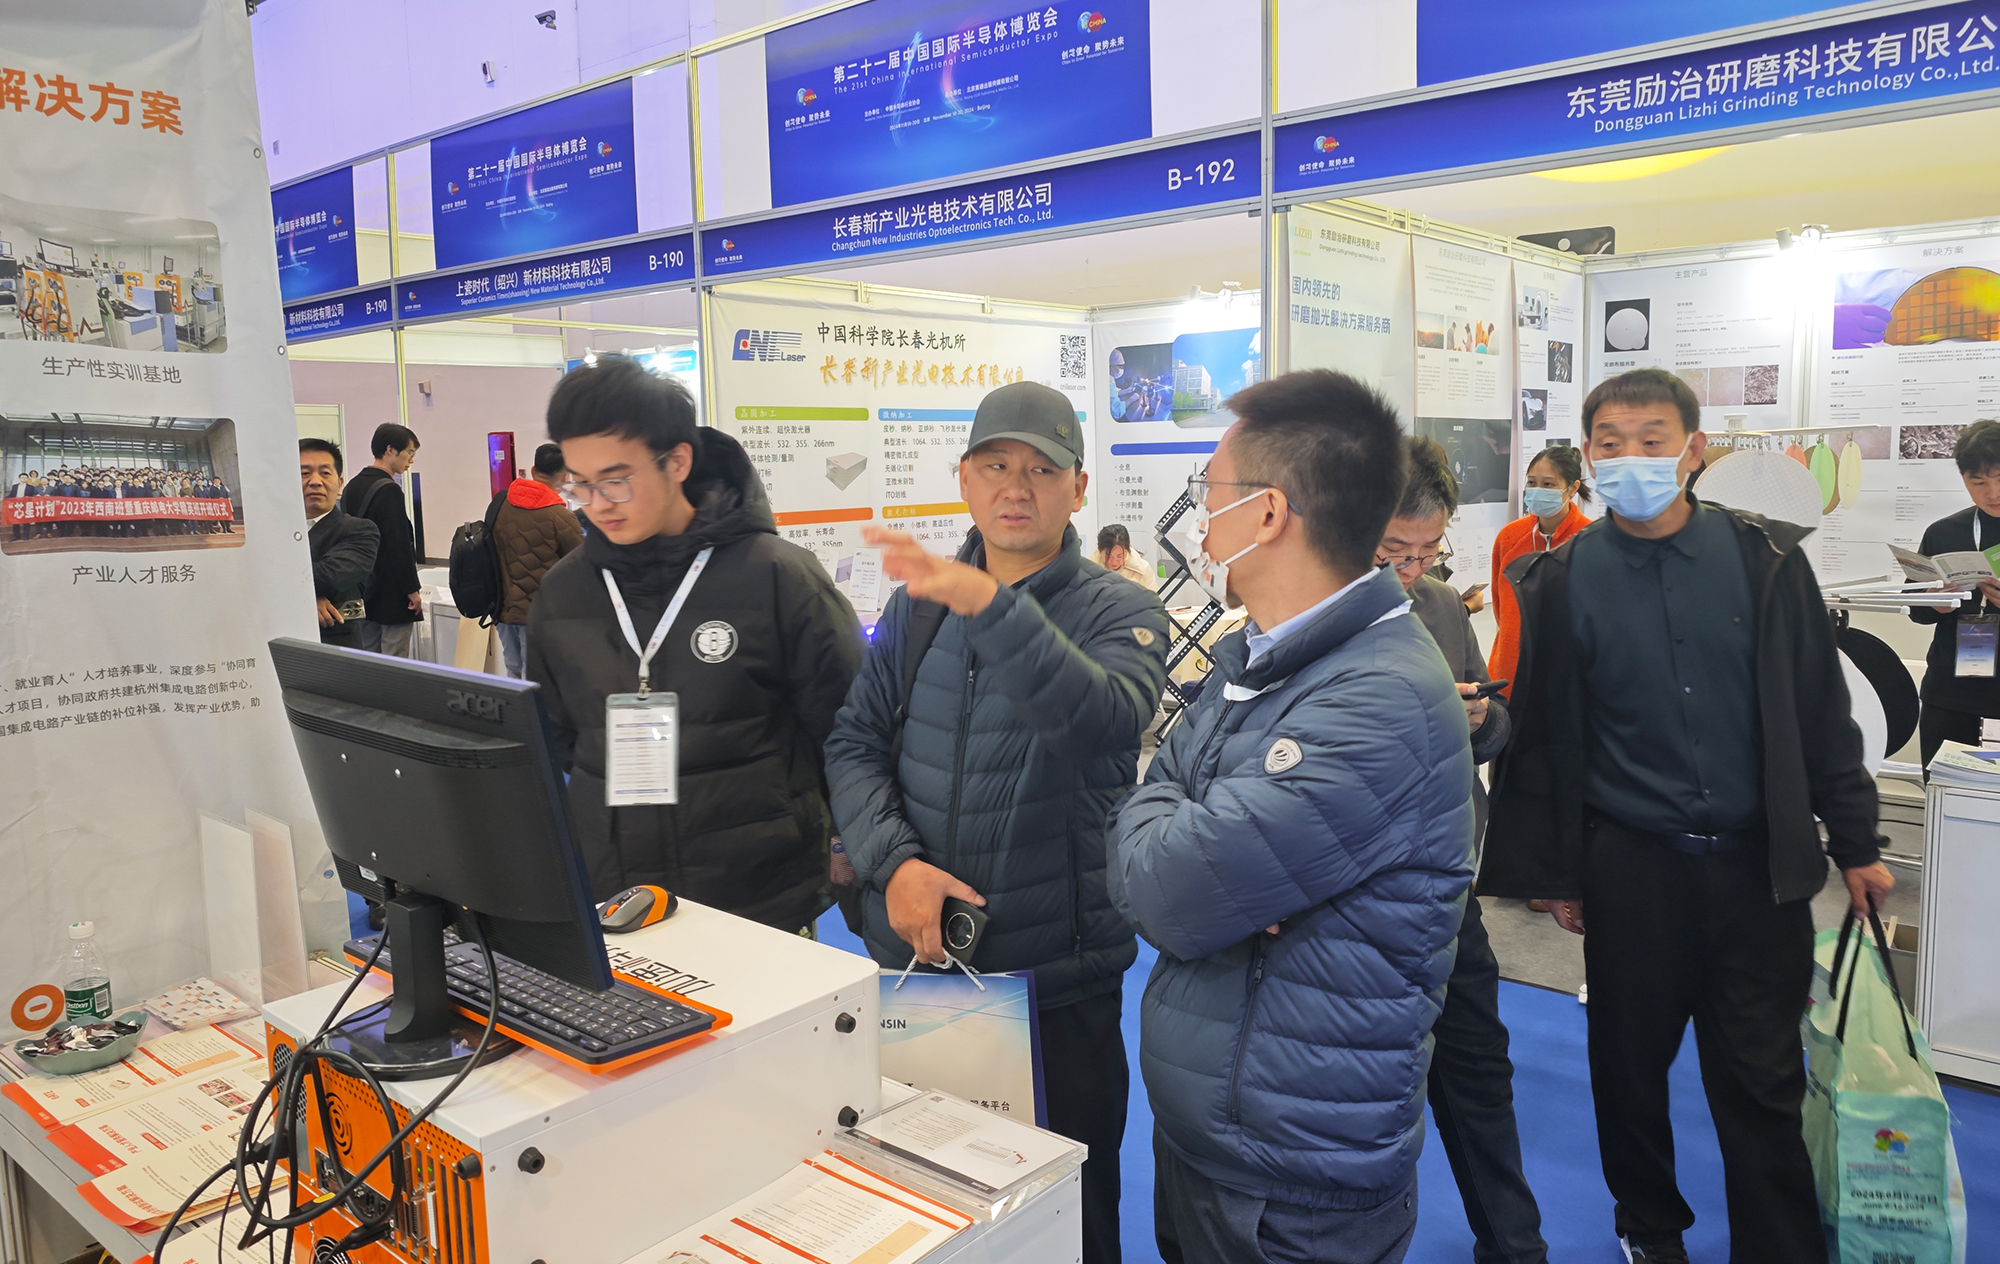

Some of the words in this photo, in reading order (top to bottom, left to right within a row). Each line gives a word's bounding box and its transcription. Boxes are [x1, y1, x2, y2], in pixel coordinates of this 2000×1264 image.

[834, 6, 1058, 85] 第二十一届中国国际半导体博览会
[834, 84, 848, 95] The
[851, 79, 868, 92] 21st
[871, 72, 895, 86] China
[898, 56, 957, 79] International
[960, 37, 1030, 64] Semiconductor
[1035, 30, 1058, 43] Expo
[1566, 14, 1998, 121] 东莞励治研磨科技有限公
[0, 67, 184, 136] 解决方案
[1594, 108, 1675, 134] Dongguan
[1679, 100, 1718, 120] Lizhi
[1722, 88, 1798, 117] Grinding
[1804, 70, 1916, 99] Technology
[1920, 56, 2000, 84] Co.,Ltd.
[1168, 158, 1235, 191] B-192
[833, 182, 1052, 239] 长春新产业光电技术有限公司
[832, 238, 871, 252] Changchun
[872, 236, 888, 246] New
[890, 229, 926, 243] Industries
[928, 218, 991, 238] Optoelectronics
[994, 214, 1016, 227] Tech.
[1018, 212, 1035, 224] Co.,
[1037, 208, 1054, 222] Ltd.
[1294, 226, 1312, 240] LIZHI
[649, 250, 684, 272] B-190
[1922, 246, 1964, 258] 解决方案
[456, 256, 612, 297] 上瓷时代（绍兴）新材料科技有限公司
[1292, 276, 1340, 300] 国内领先的
[1674, 268, 1708, 279] 主营产品
[366, 299, 387, 314] B-190
[461, 297, 477, 306] Superior
[478, 294, 496, 303] Ceramics
[530, 286, 539, 294] New
[540, 284, 559, 293] Material
[560, 280, 586, 291] Technology
[289, 303, 344, 326] 新材料科技有限公司
[817, 322, 966, 352] 中国科学院长春光机所
[41, 356, 182, 385] 生产性实训基地
[781, 352, 806, 362] Laser
[819, 355, 1024, 389] 长春新产业光电技术有限公司
[750, 454, 795, 462] 导体检测/量测
[72, 564, 197, 586] 产业人才服务
[0, 657, 256, 693] 、就业育人”人才培养事业，深度参与“协同育
[447, 688, 506, 721] acer
